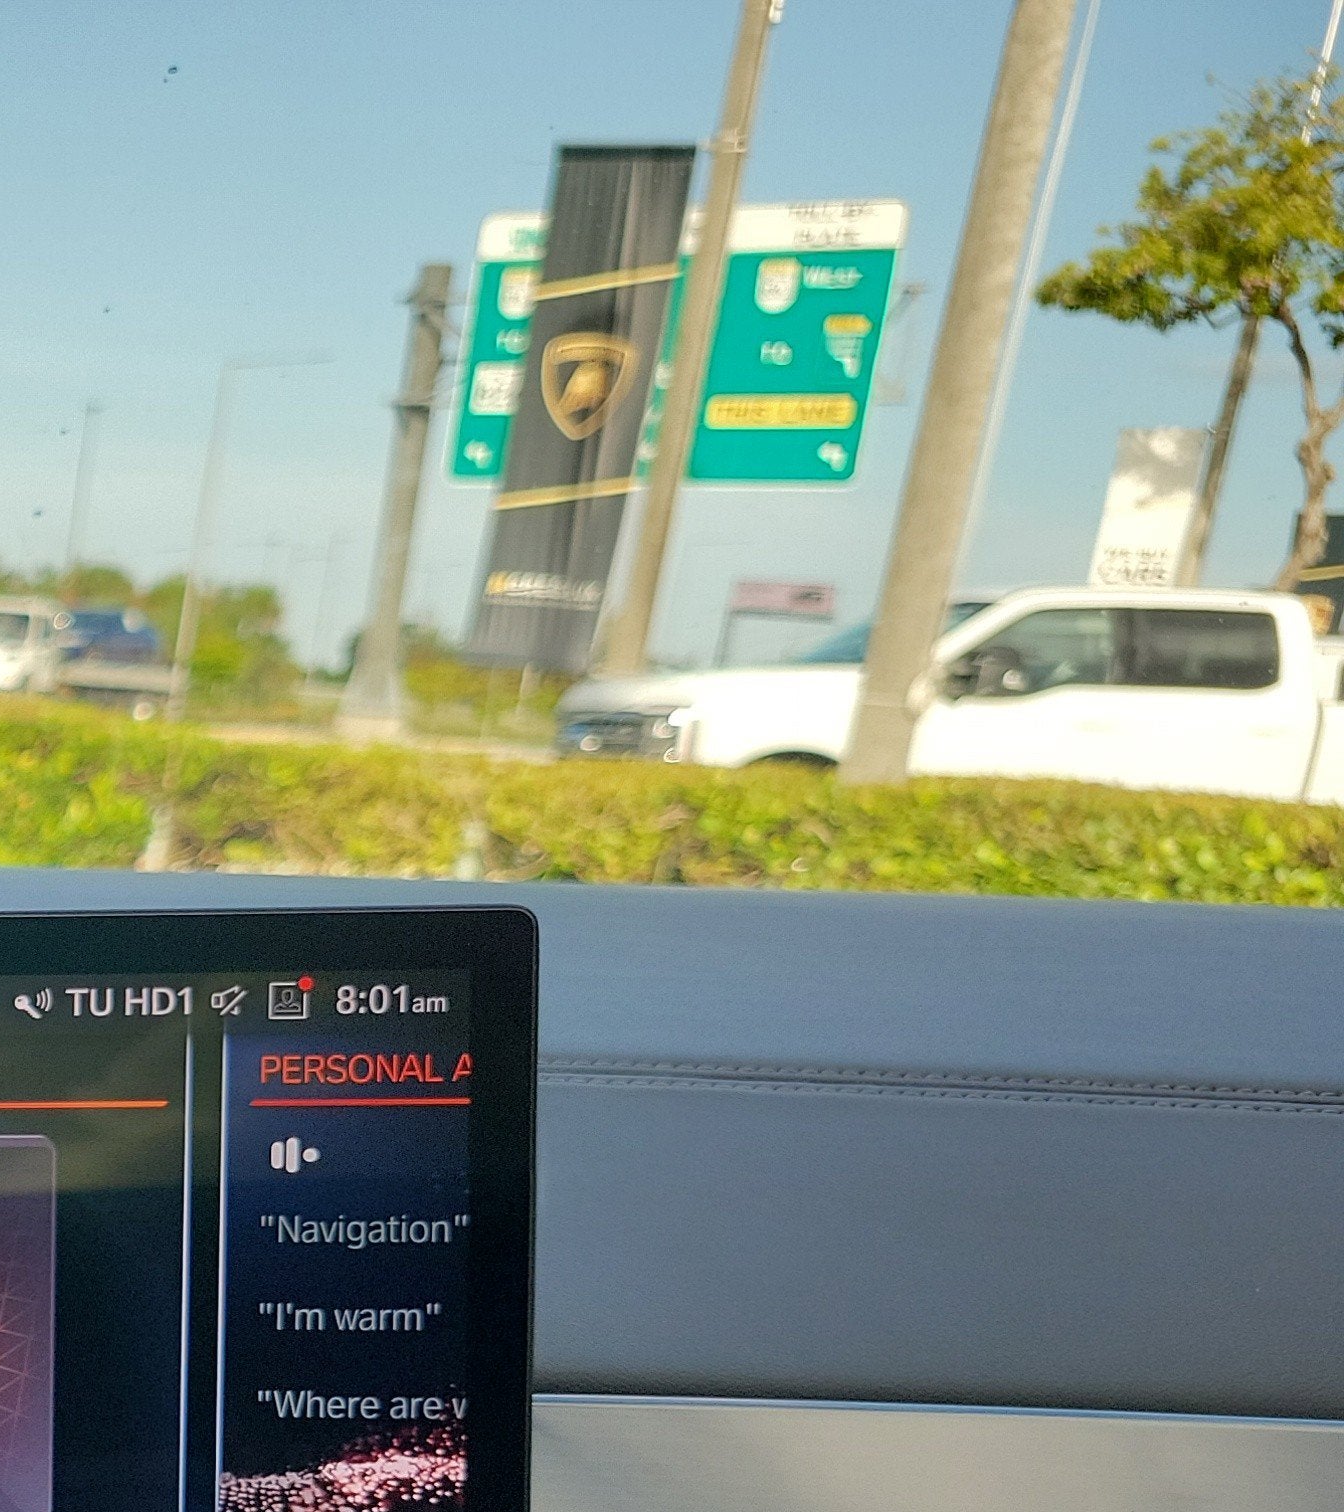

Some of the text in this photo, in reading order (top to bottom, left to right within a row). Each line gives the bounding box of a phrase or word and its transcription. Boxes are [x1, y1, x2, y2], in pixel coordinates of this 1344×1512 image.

[65, 986, 193, 1017] TU HD1
[260, 1053, 445, 1085] PERSONAL
[259, 1214, 471, 1250] "Navigation"
[258, 1302, 443, 1333] "I'm warm"
[257, 1390, 382, 1421] "Where
[389, 1396, 444, 1420] are
